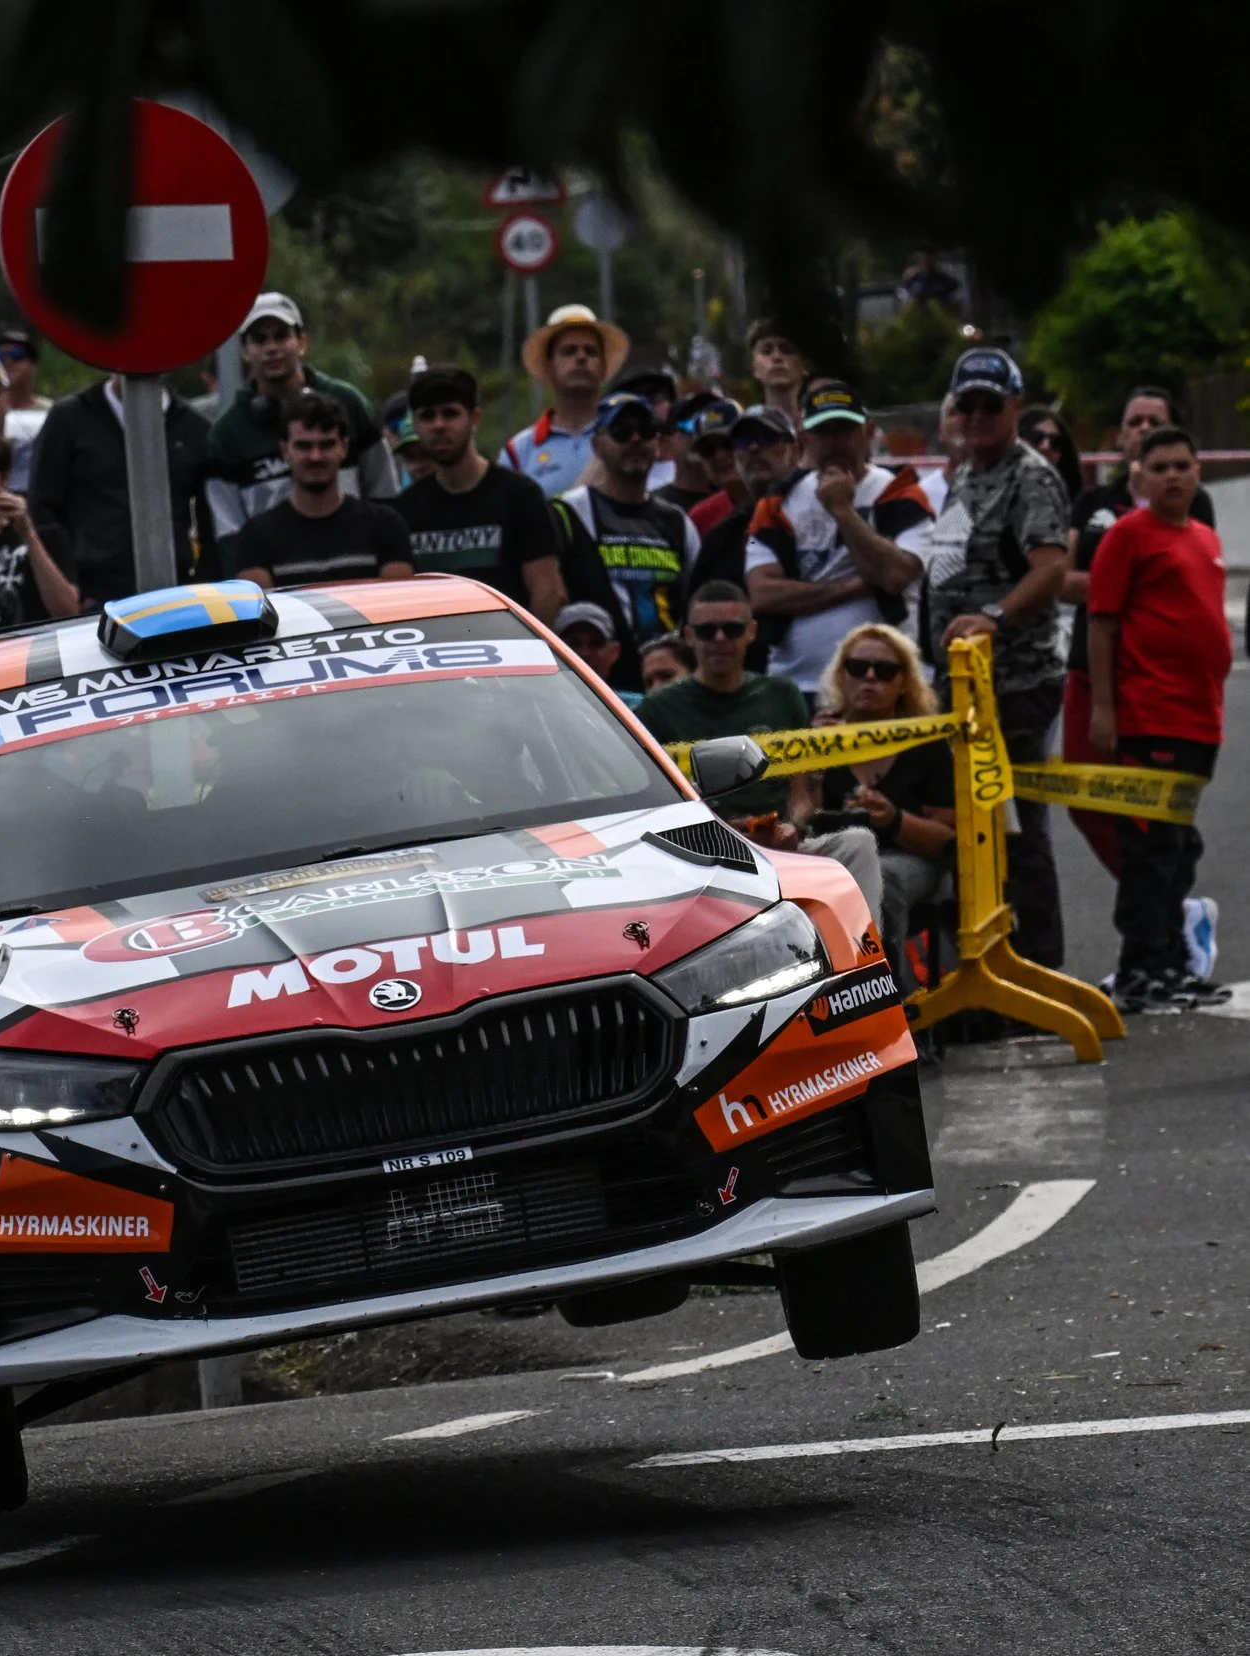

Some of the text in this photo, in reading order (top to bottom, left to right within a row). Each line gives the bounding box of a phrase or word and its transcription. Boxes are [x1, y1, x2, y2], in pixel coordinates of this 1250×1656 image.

[16, 643, 502, 737] FORUM8
[77, 628, 425, 696] MUNARETTO
[117, 683, 327, 726] フォーラムエイト
[227, 854, 609, 917] CARLSSON
[227, 926, 546, 1009] MOTUL
[854, 932, 880, 957] MS
[767, 1050, 884, 1115] HYRMASKINER
[387, 1149, 466, 1171] NR S 109
[0, 1215, 150, 1237] HYRMASKINER
